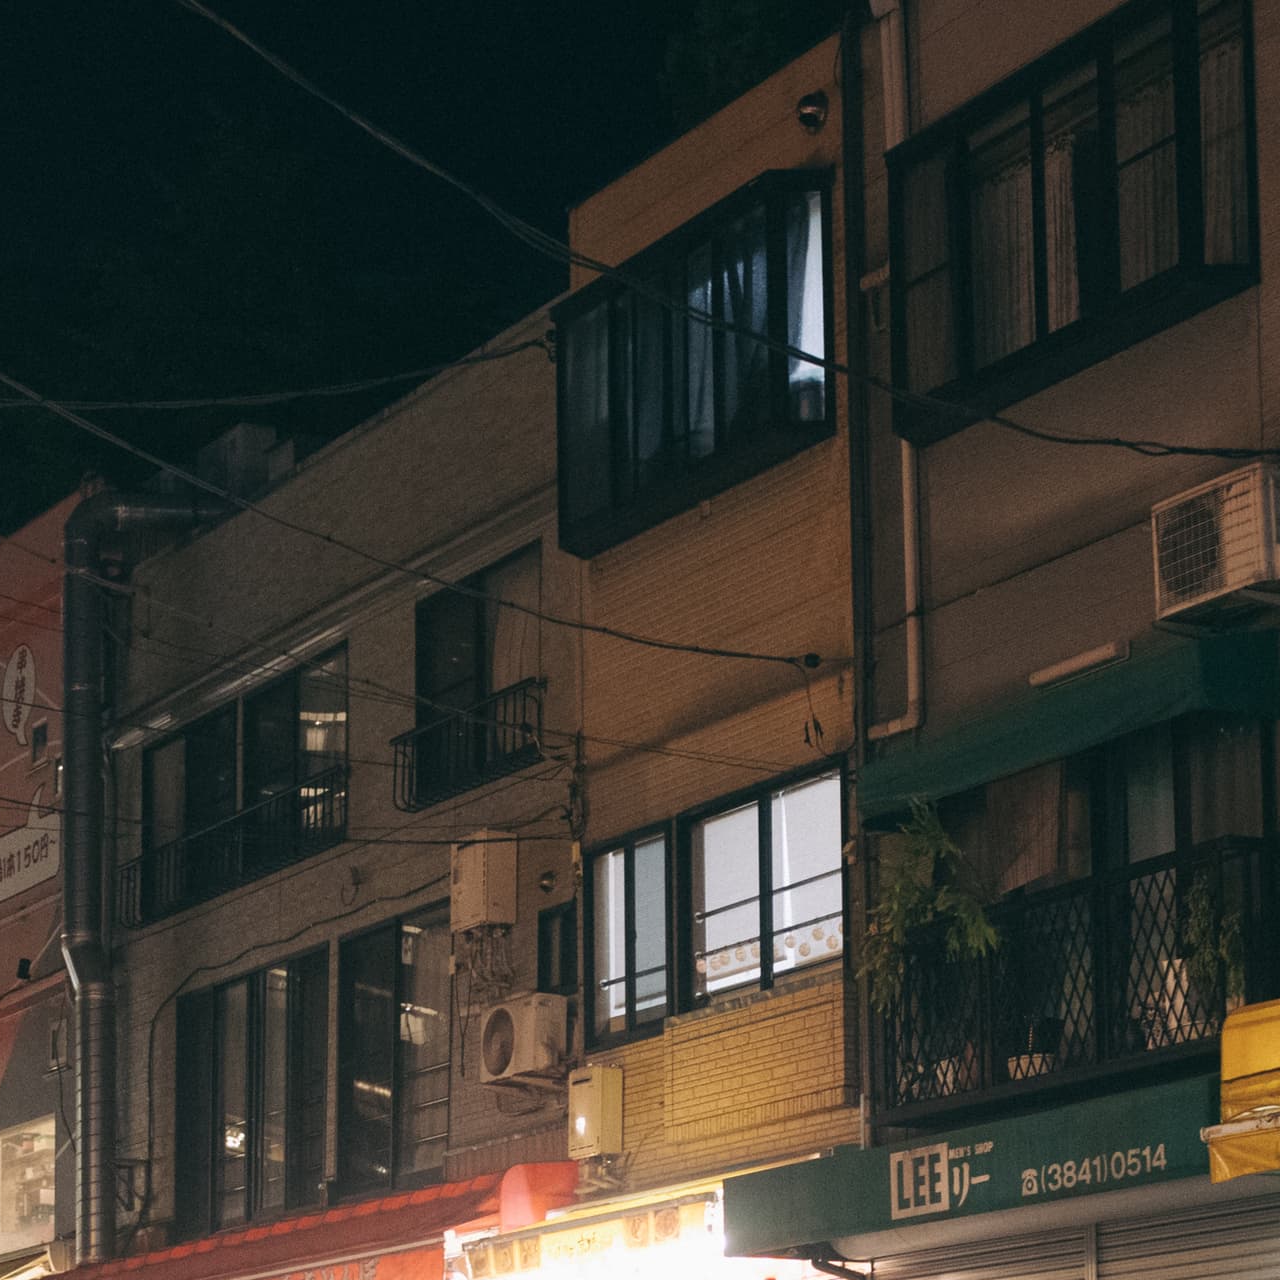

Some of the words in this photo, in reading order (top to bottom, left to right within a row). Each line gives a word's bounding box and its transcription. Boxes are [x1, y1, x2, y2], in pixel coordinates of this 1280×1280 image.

[948, 1146, 971, 1160] MEN'S
[974, 1141, 994, 1155] SHOP
[1041, 1143, 1167, 1193] (3841)0514
[893, 1146, 948, 1216] LEE
[952, 1161, 991, 1208] リー
